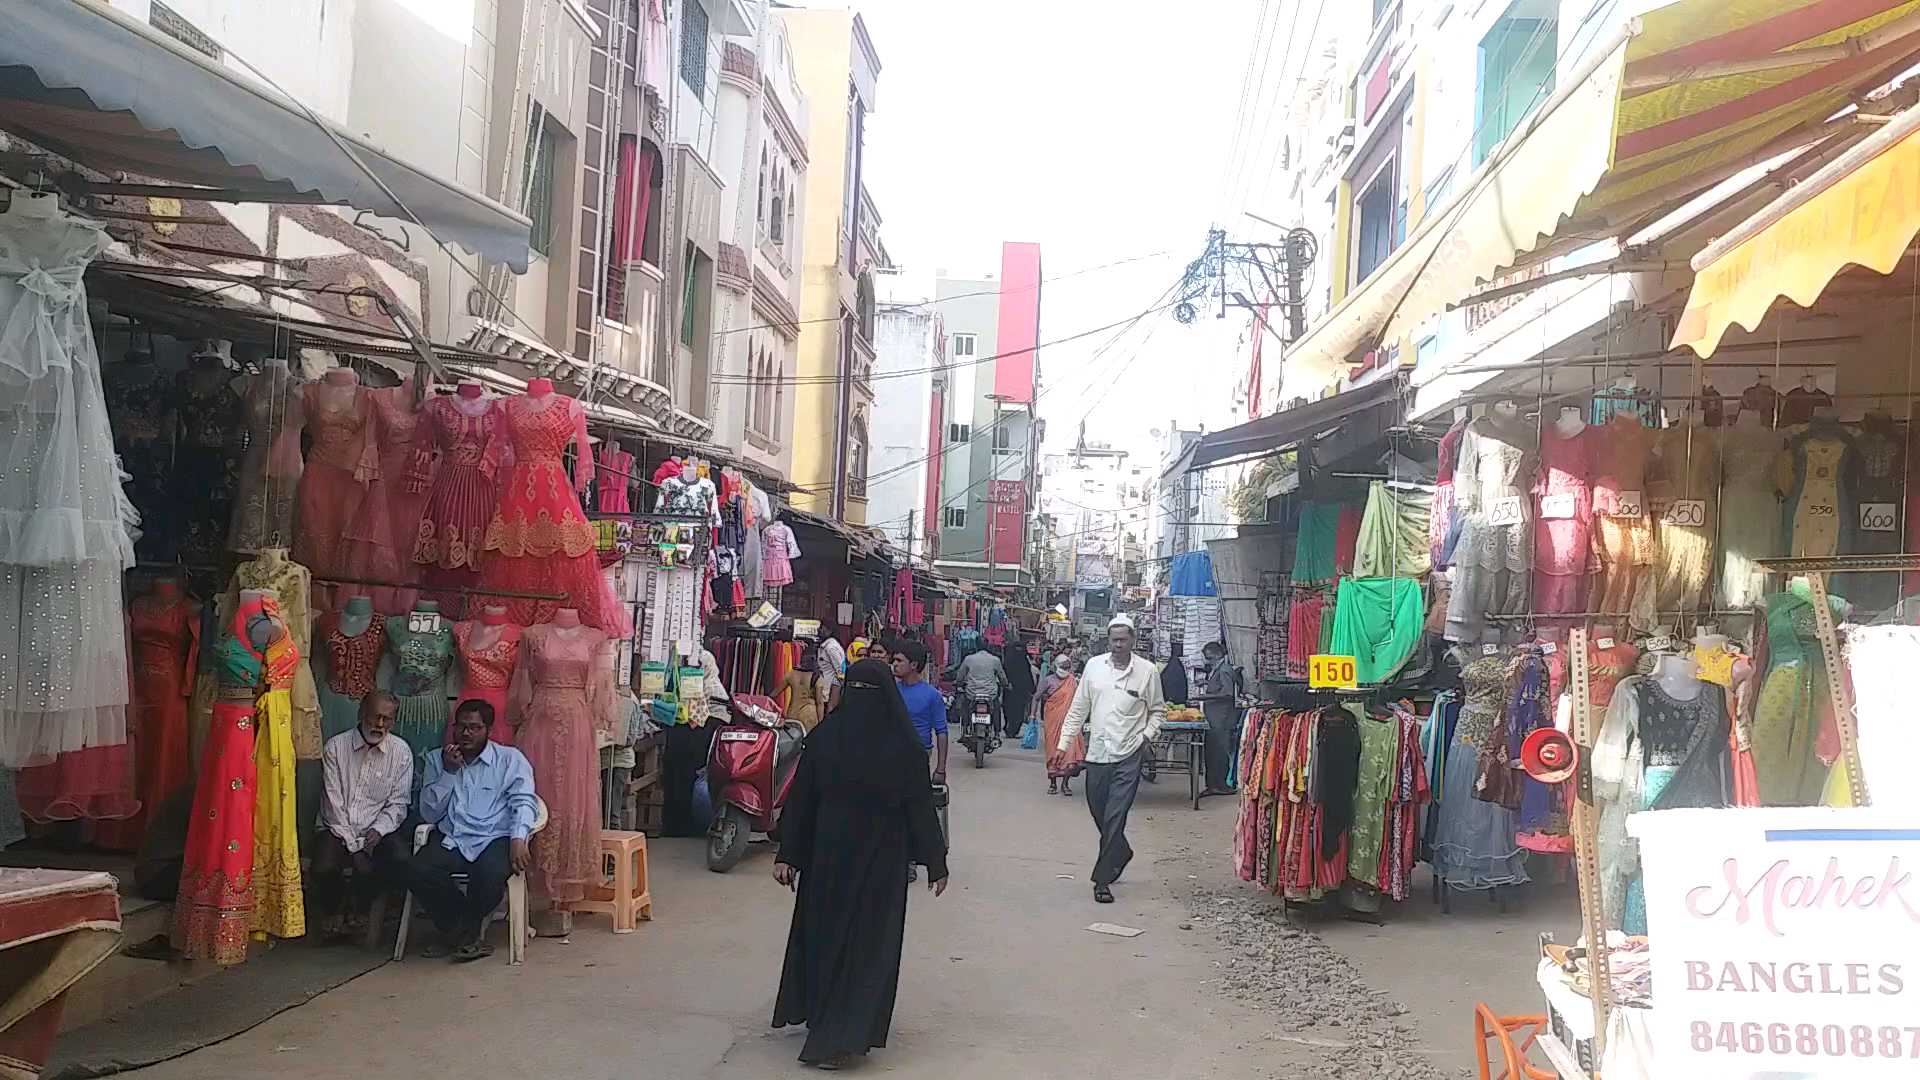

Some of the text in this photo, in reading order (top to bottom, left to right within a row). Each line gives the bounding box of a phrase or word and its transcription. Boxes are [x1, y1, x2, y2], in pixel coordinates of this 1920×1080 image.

[1491, 501, 1519, 522] 650
[1665, 503, 1703, 523] 650
[1862, 506, 1894, 528] 600
[1313, 662, 1354, 682] 150
[1684, 855, 1920, 937] Mahek
[1684, 960, 1904, 995] BANGLES
